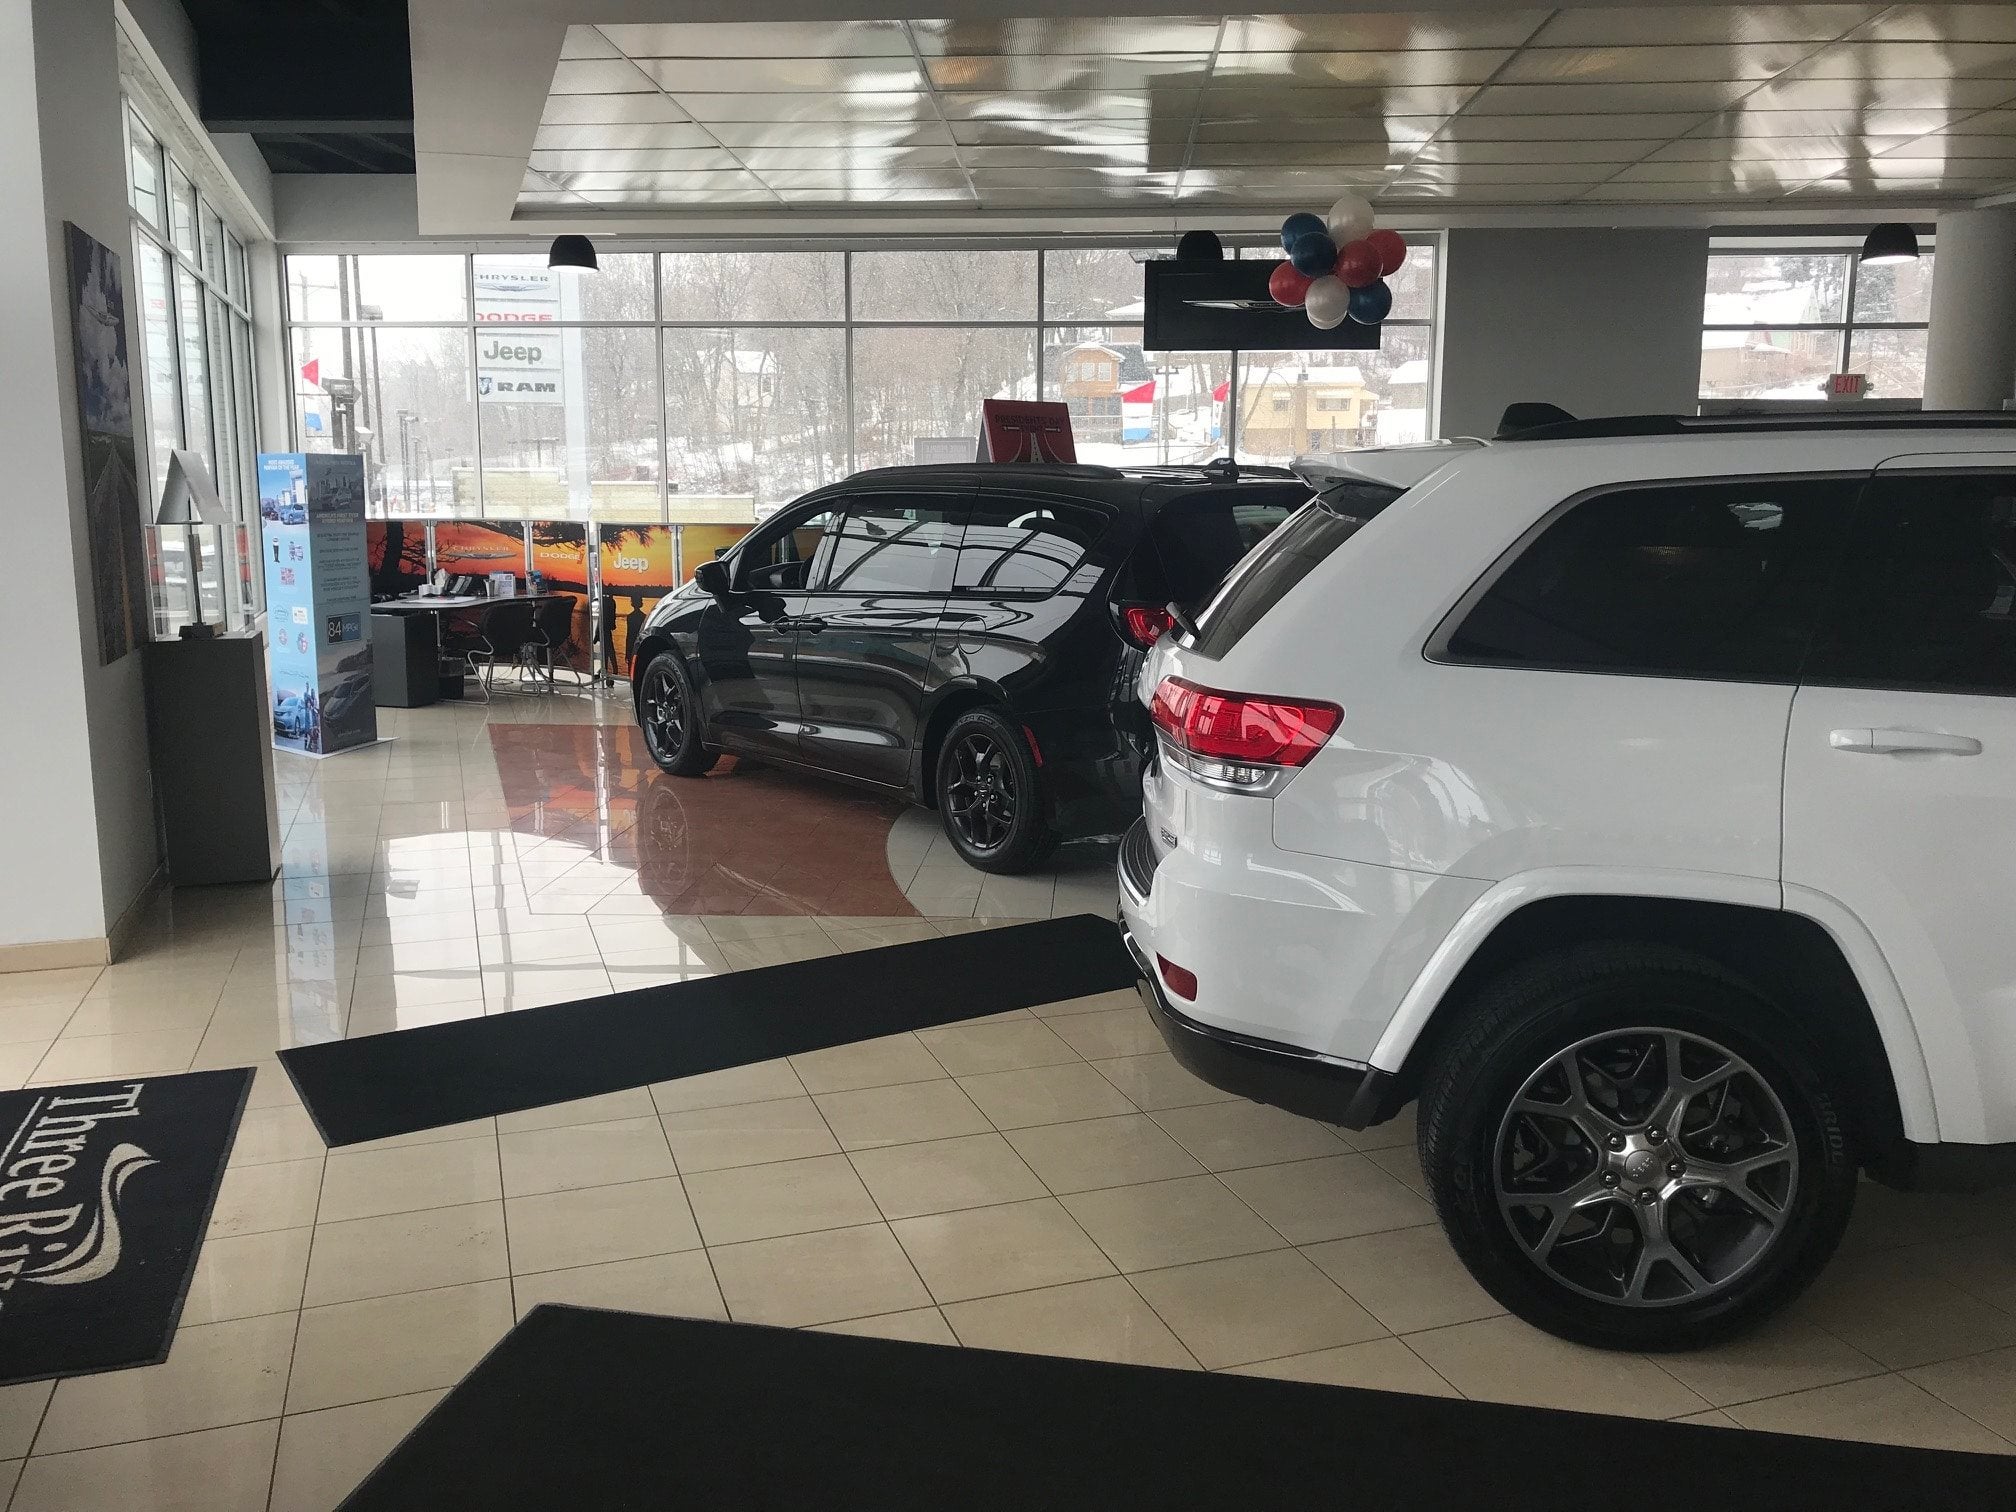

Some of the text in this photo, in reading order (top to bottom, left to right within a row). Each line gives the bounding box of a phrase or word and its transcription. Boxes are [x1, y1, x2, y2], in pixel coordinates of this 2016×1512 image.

[483, 340, 542, 365] Jeep
[497, 382, 556, 392] RAM
[1835, 375, 1861, 393] EXIT
[540, 552, 580, 560] DODGE
[613, 552, 649, 574] Jeep
[328, 621, 342, 637] 84
[0, 1083, 145, 1201] Three
